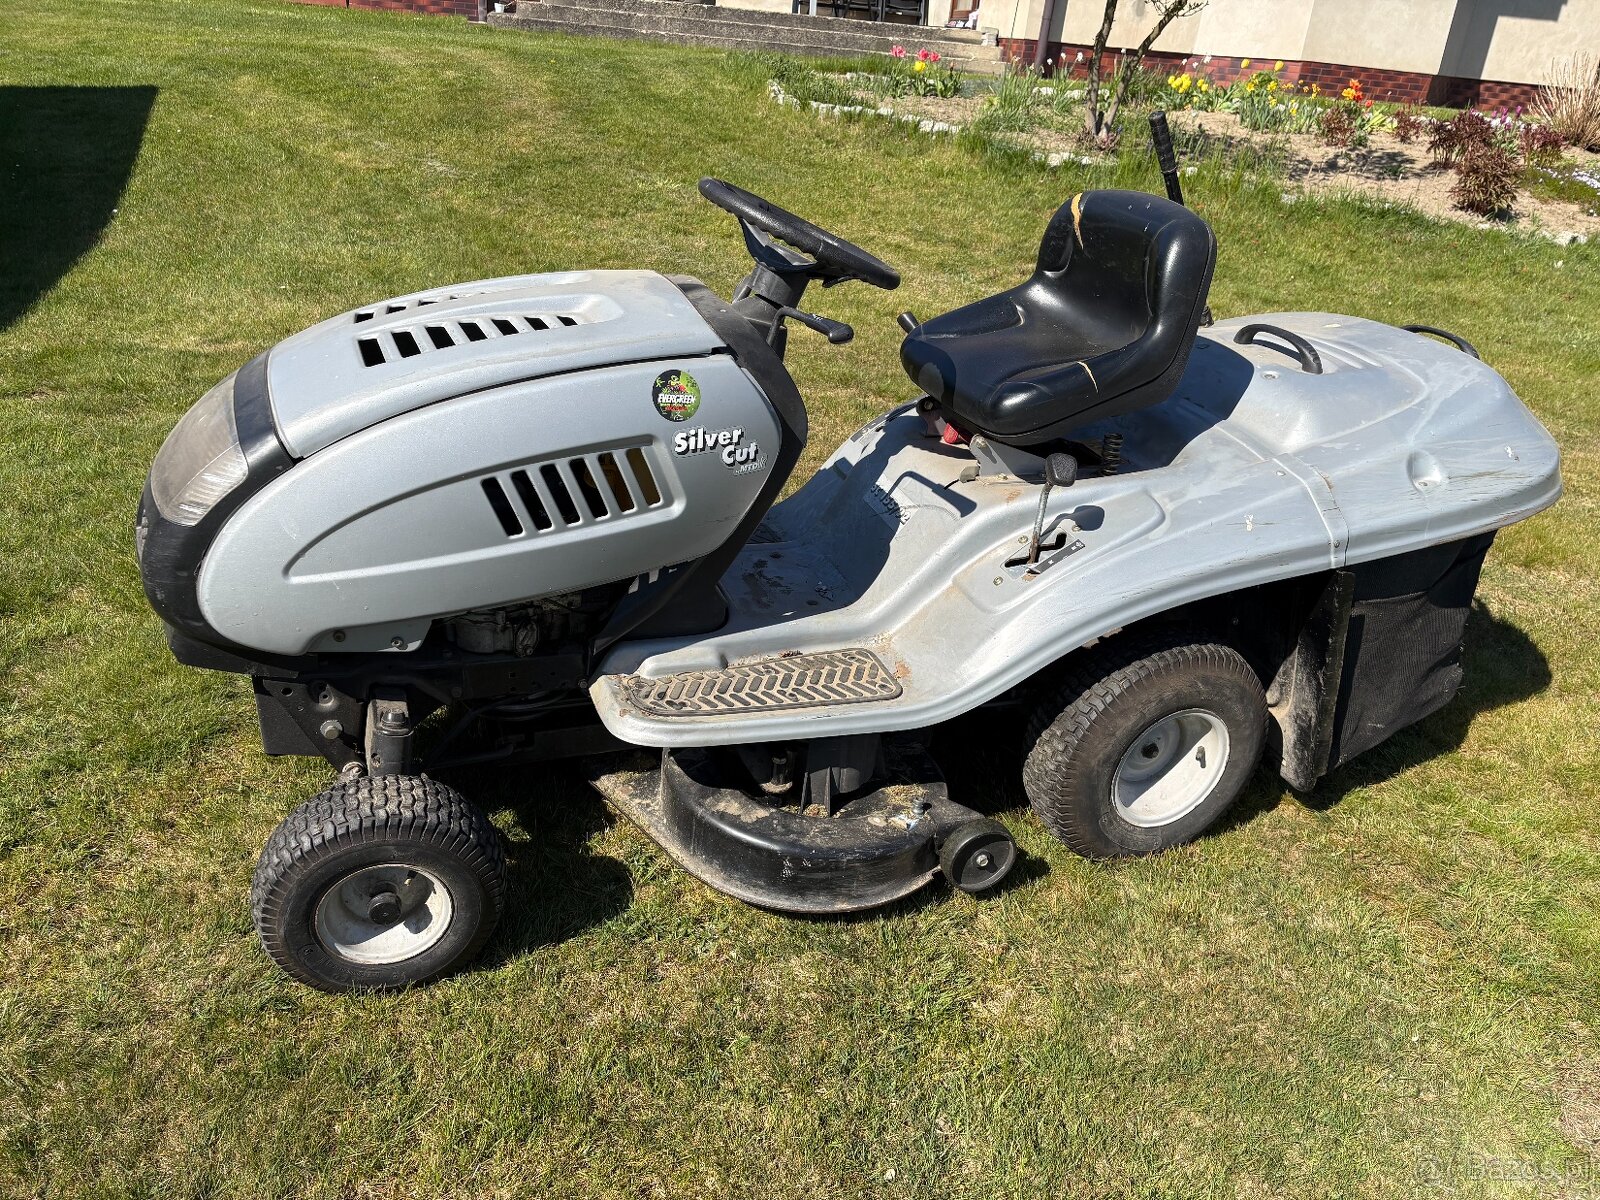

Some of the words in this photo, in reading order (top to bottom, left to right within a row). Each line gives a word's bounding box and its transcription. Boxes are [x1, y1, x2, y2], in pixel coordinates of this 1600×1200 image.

[657, 393, 696, 404] EVERGREEN
[674, 427, 745, 455] Silver
[721, 442, 760, 467] Cut
